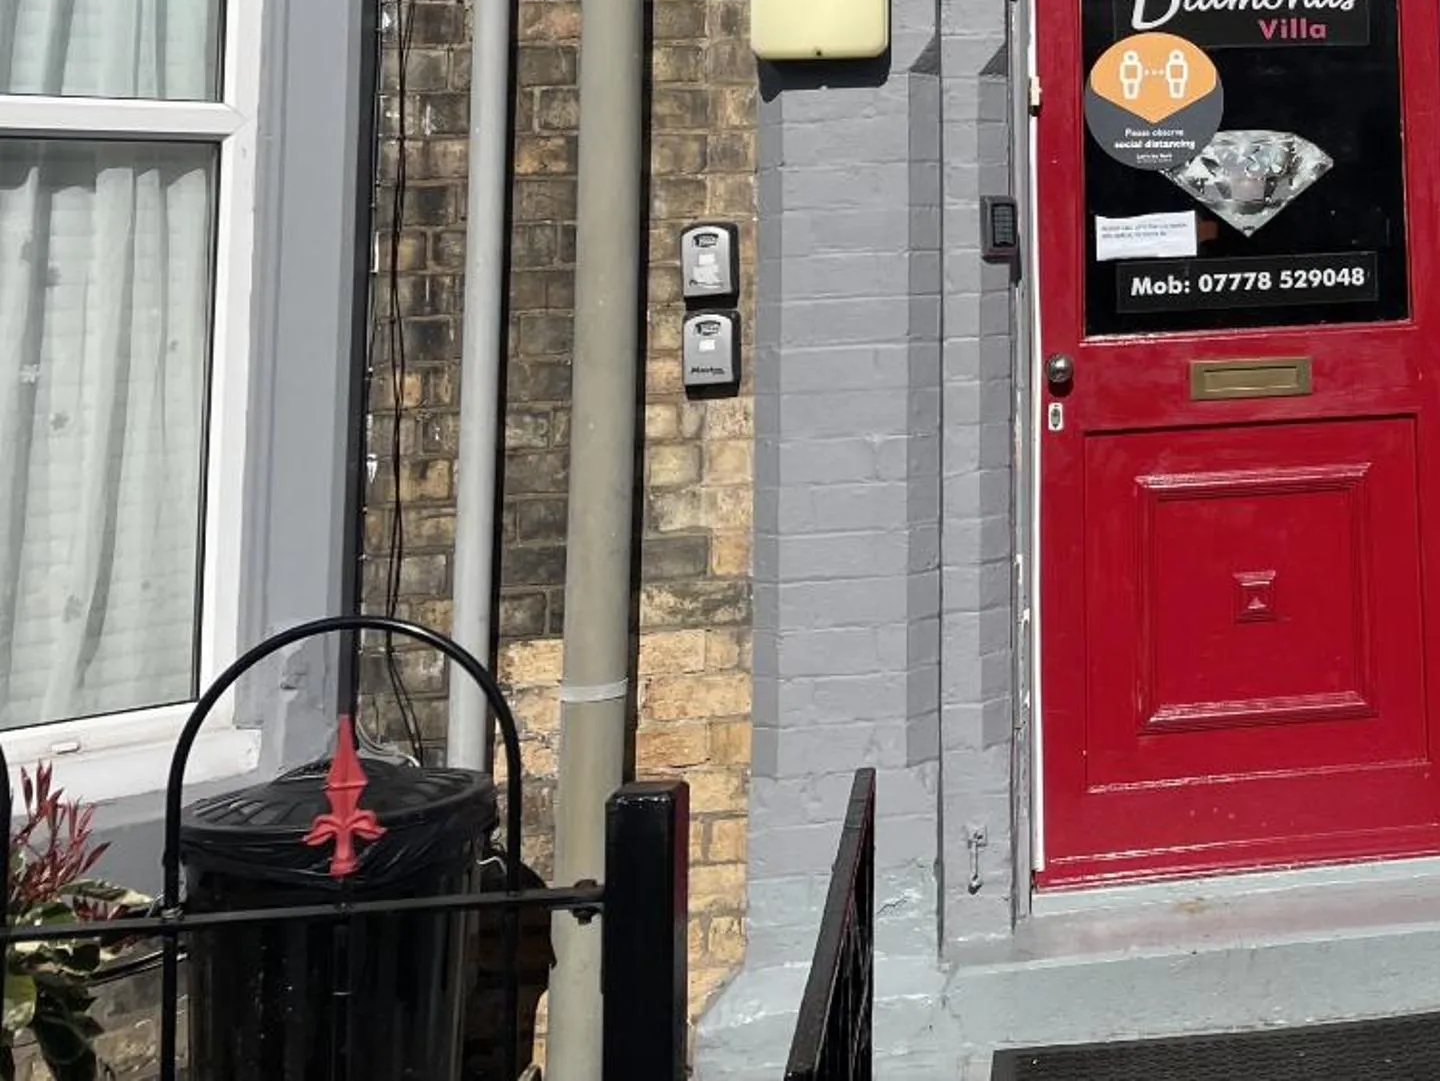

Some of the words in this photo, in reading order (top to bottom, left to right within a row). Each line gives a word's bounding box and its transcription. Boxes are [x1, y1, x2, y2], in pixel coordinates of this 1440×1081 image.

[1259, 18, 1327, 39] Villa
[1115, 141, 1143, 149] social
[1144, 140, 1196, 150] distancing
[1131, 276, 1190, 296] Mob:
[1199, 272, 1272, 293] 07778
[1279, 267, 1365, 289] 529048
